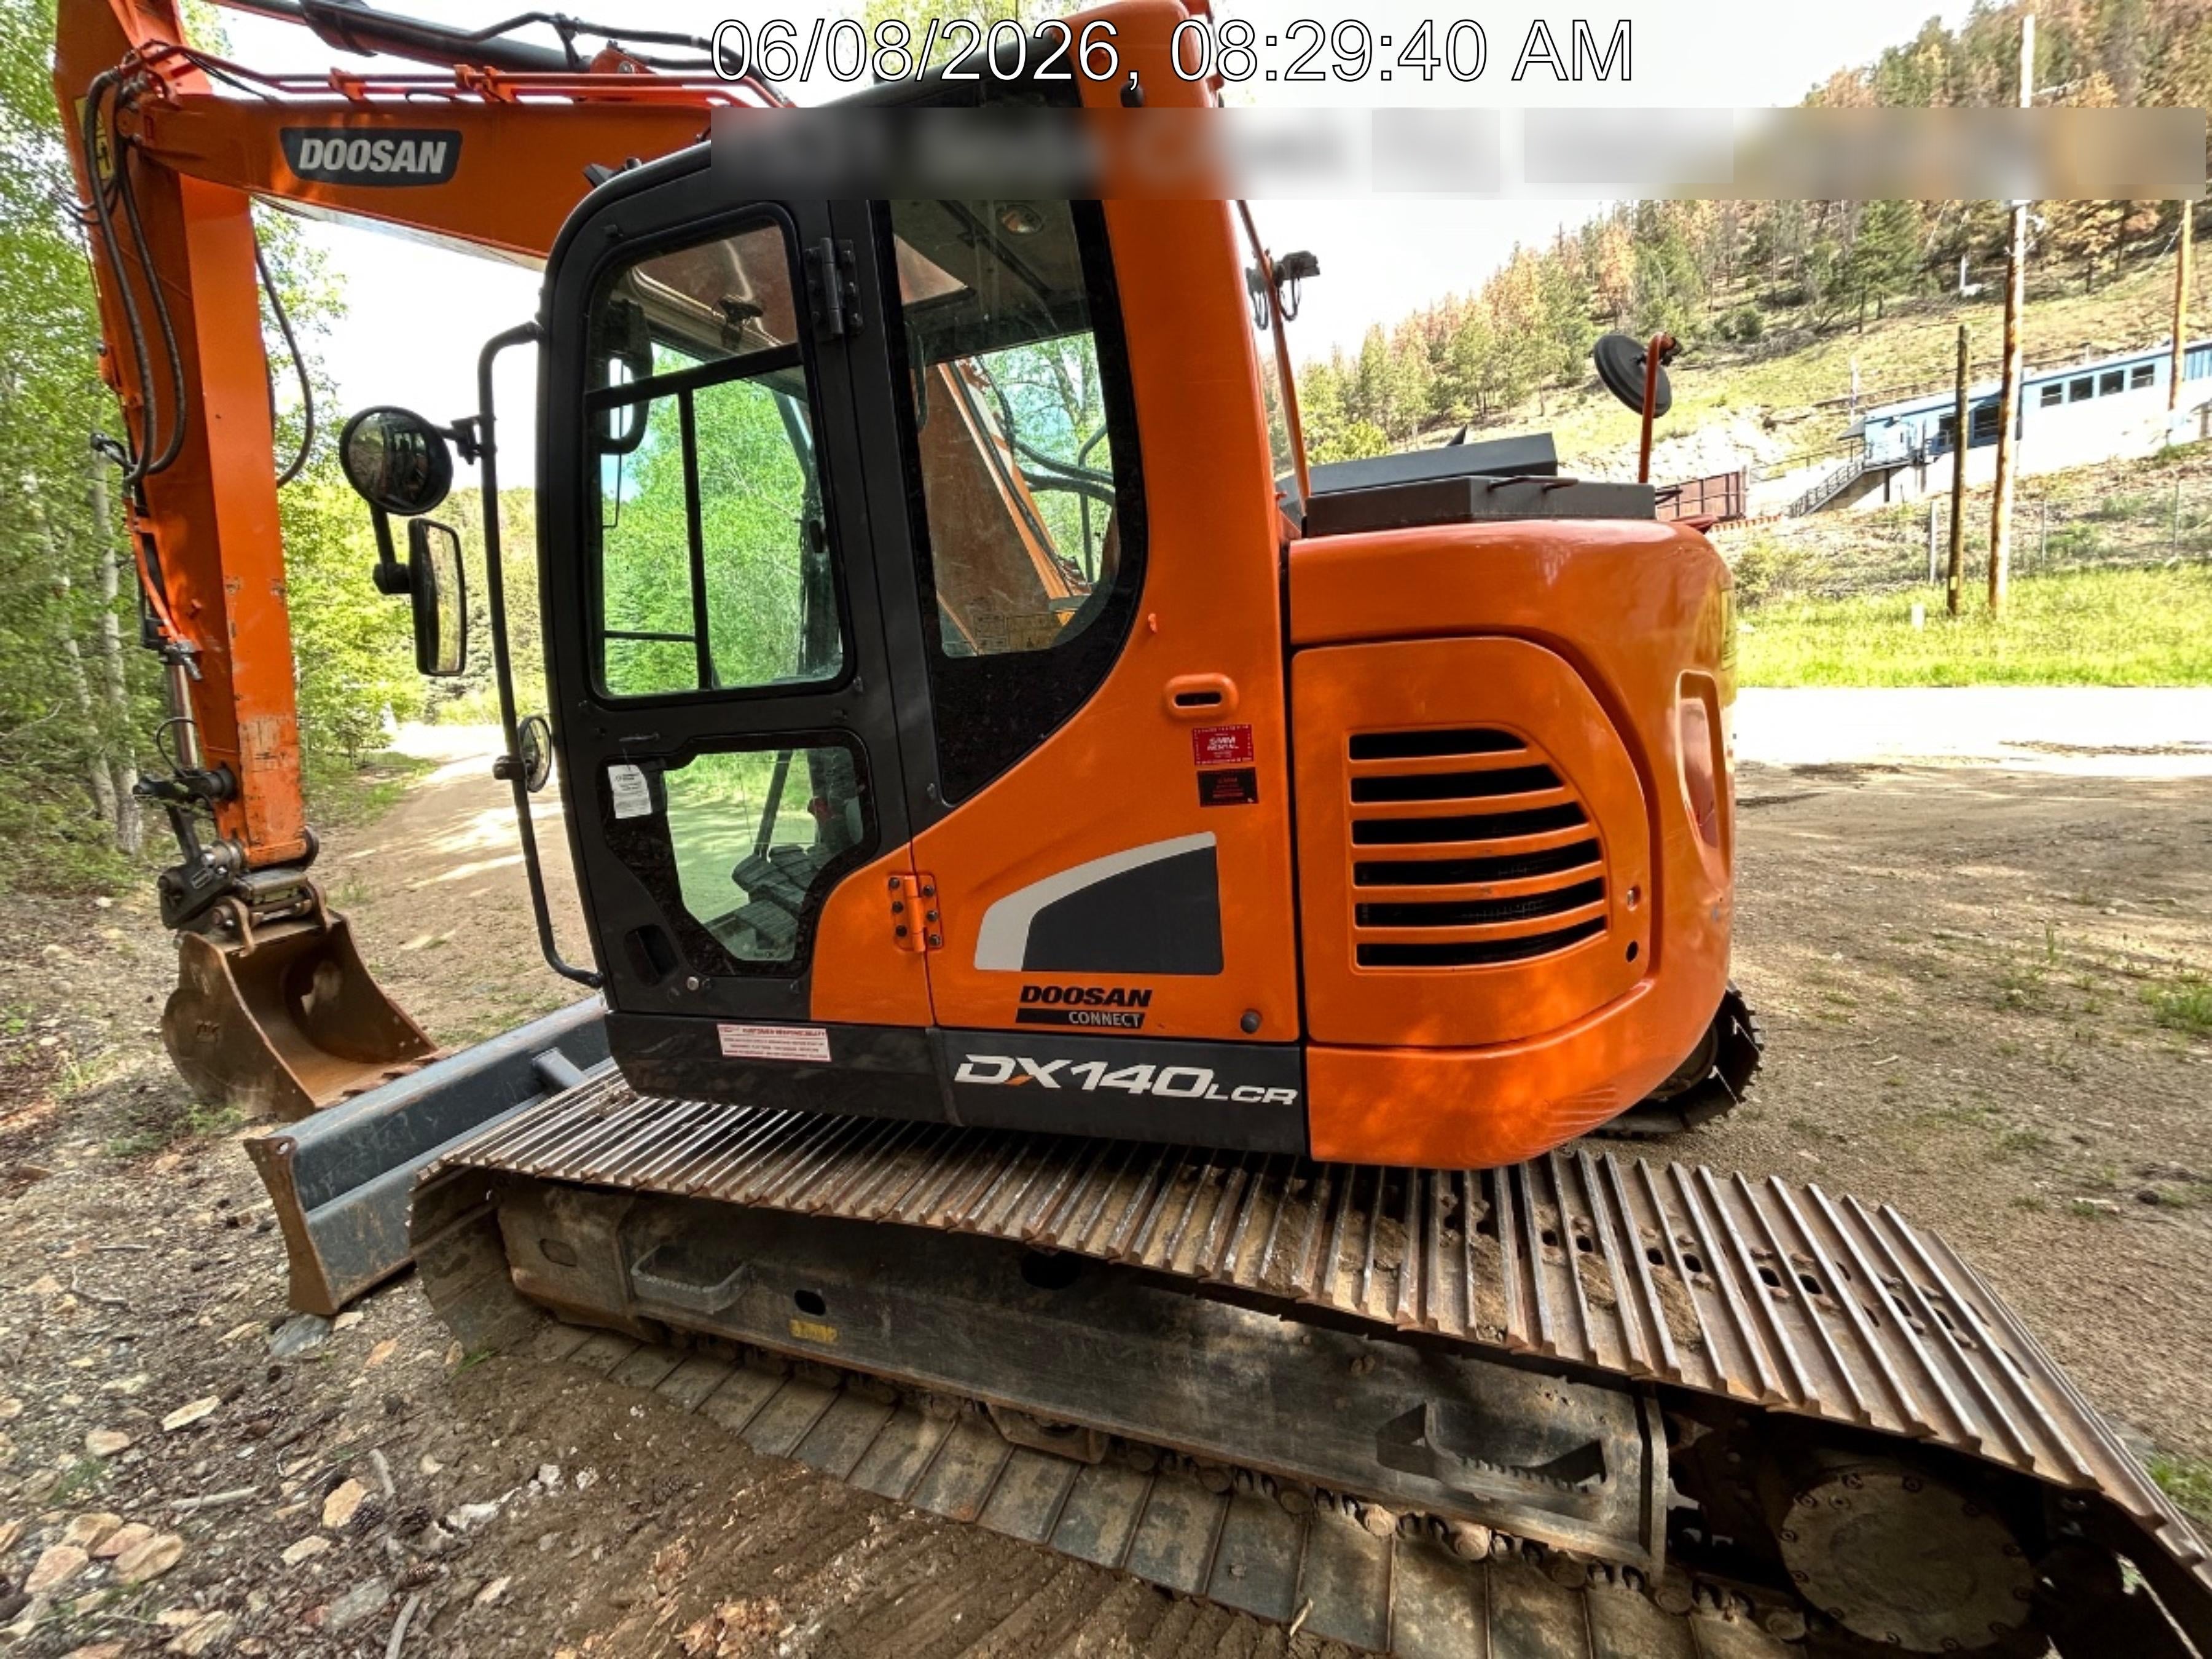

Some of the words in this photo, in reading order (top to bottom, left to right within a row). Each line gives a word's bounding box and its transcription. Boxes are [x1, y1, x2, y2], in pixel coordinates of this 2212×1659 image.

[299, 138, 447, 174] DOOSAN
[1019, 986, 1152, 1006] DOOSAN
[1069, 1011, 1141, 1027] CONNECT
